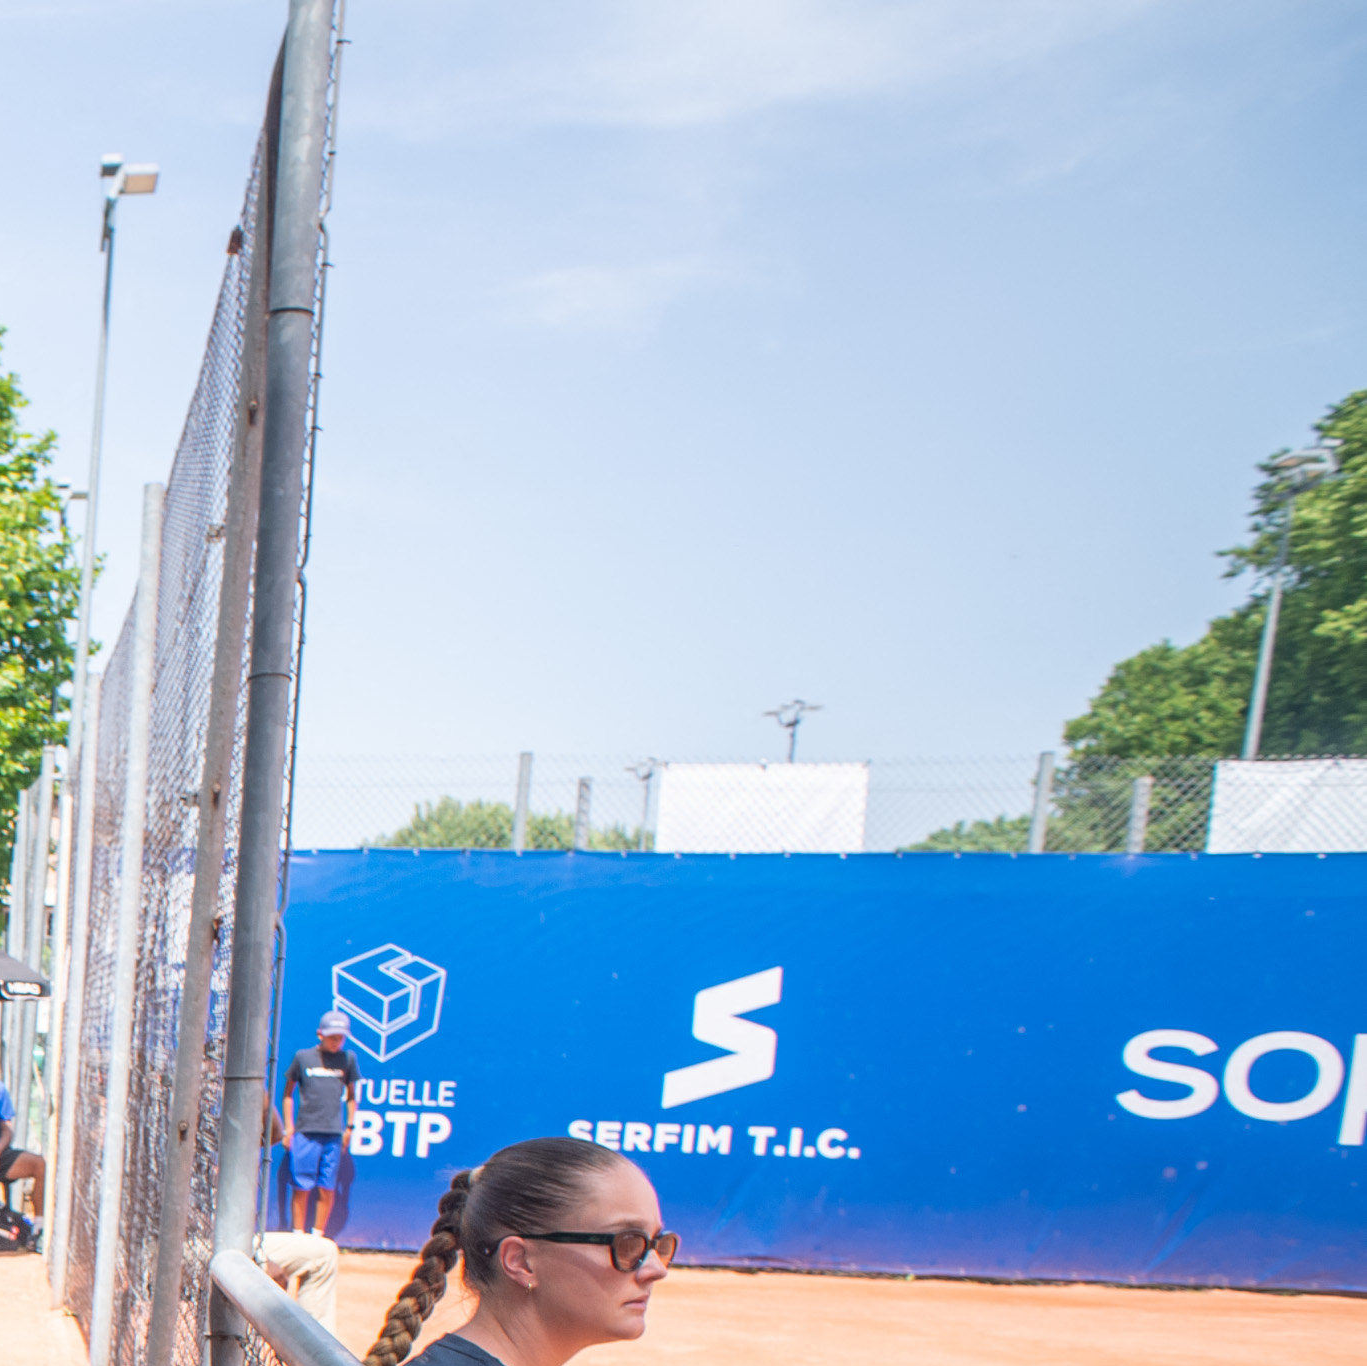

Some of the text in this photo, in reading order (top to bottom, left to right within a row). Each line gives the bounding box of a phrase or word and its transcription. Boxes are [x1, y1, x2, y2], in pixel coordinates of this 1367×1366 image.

[343, 1078, 457, 1108] TUELLE
[349, 1110, 453, 1159] BTP
[568, 1119, 862, 1160] SERFIM T.I.C.
